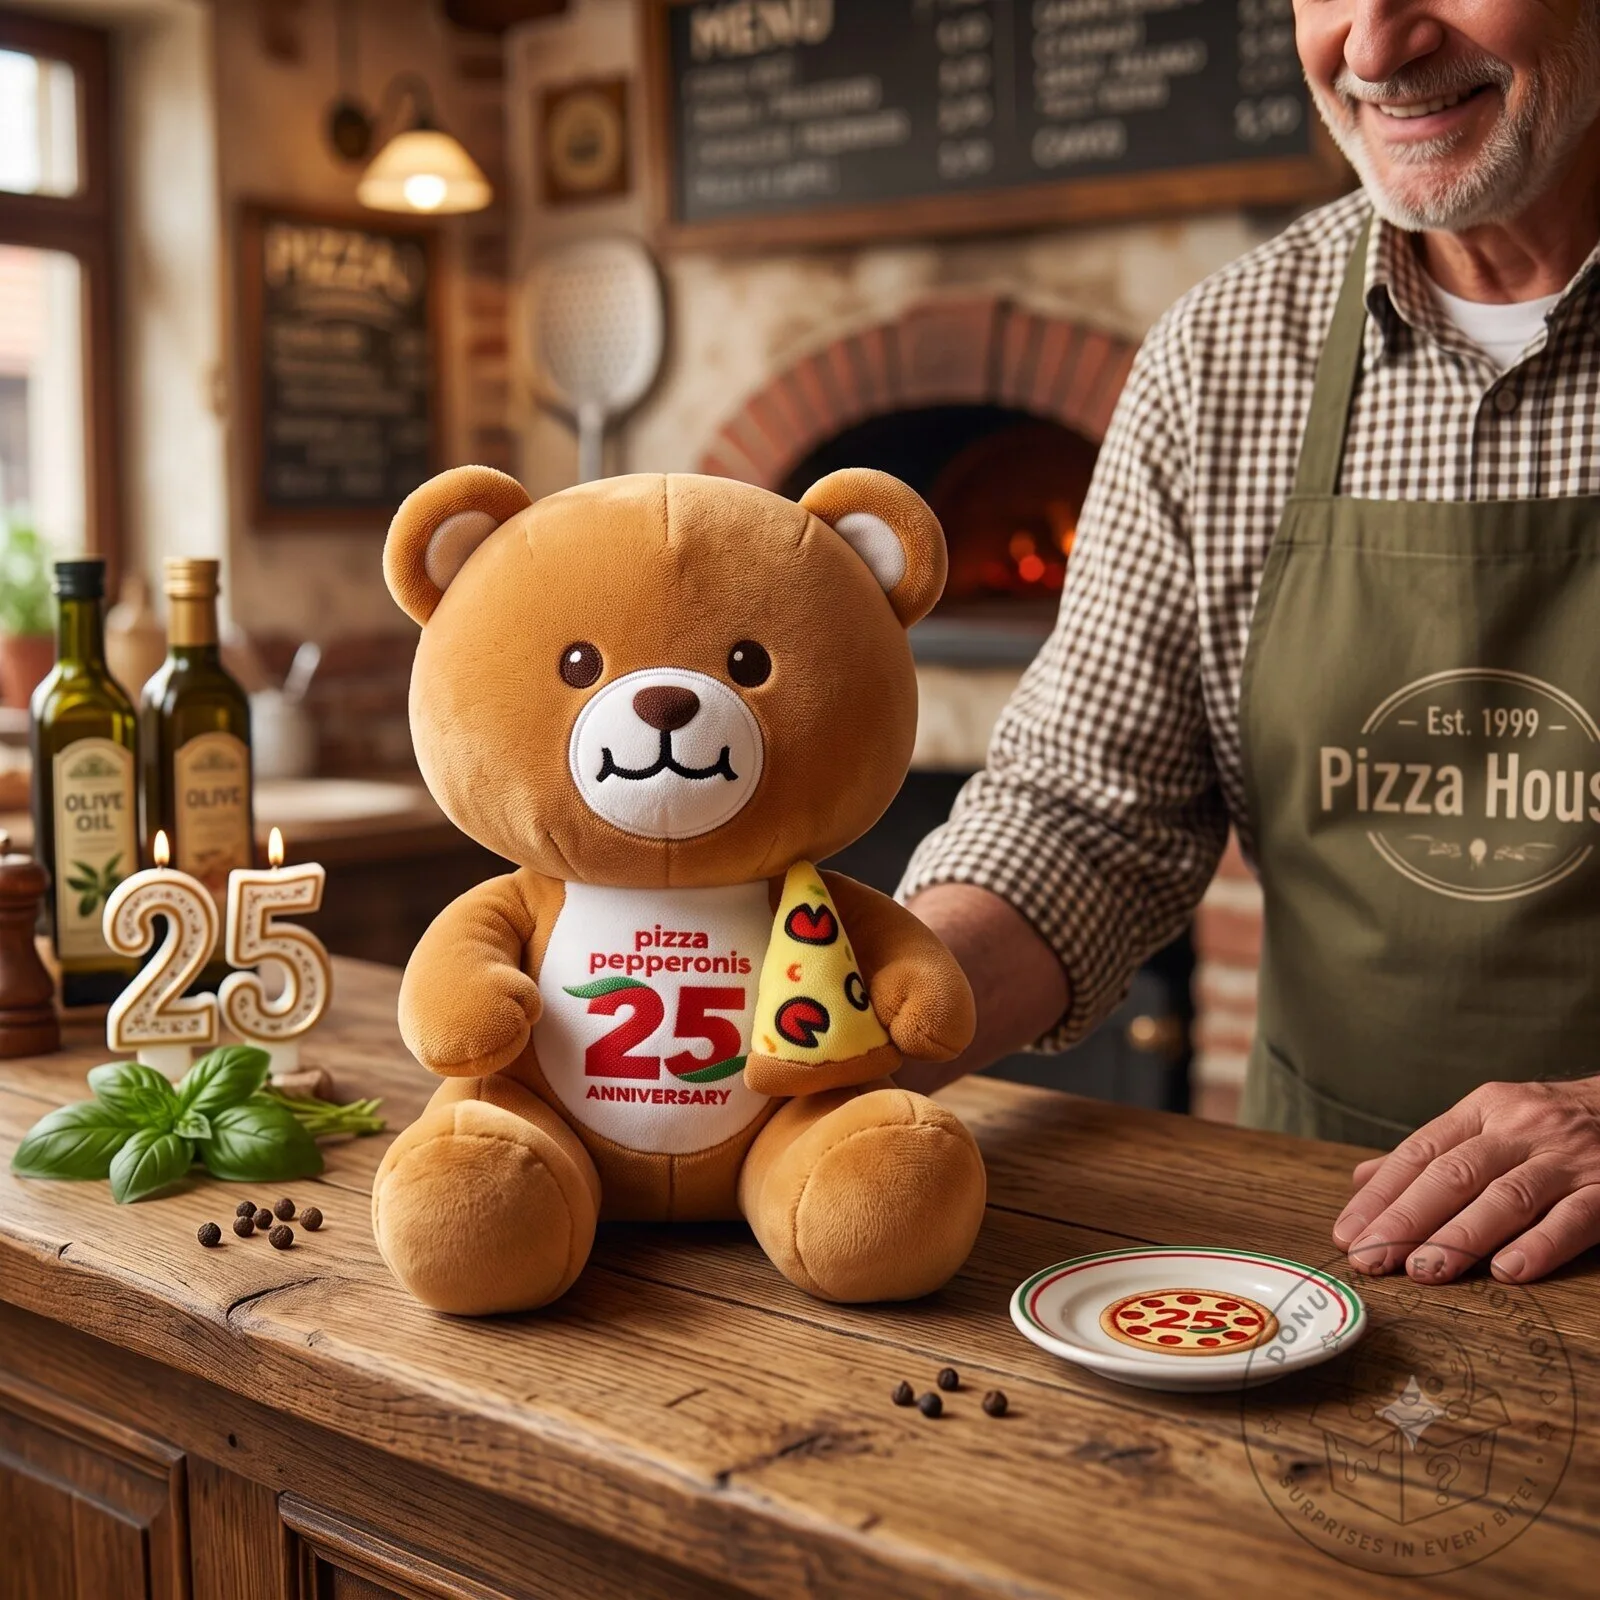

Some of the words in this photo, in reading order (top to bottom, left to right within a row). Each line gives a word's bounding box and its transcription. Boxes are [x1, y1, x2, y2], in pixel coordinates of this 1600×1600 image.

[1427, 705, 1471, 735] Est.
[1482, 708, 1539, 738] 1999
[1320, 747, 1463, 816] Pizza
[65, 791, 125, 812] OLIVE
[76, 814, 115, 832] OIL
[635, 925, 709, 951] pizza
[102, 862, 333, 1052] 25
[589, 951, 752, 977] pepperonis
[585, 985, 746, 1083] 25
[586, 1084, 732, 1106] ANNIVERSARY
[1149, 1307, 1229, 1331] 25
